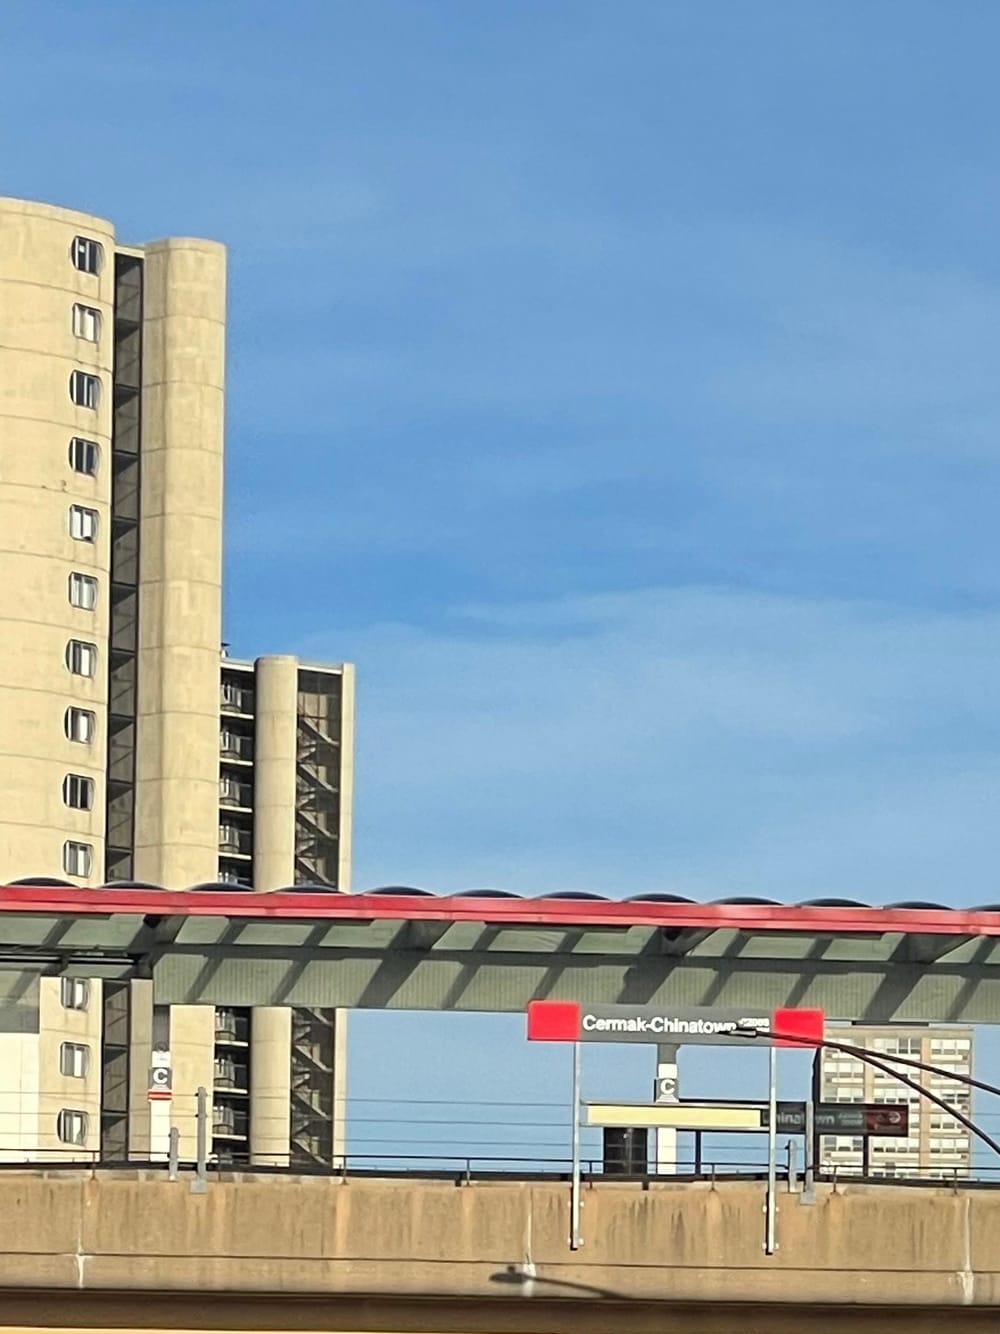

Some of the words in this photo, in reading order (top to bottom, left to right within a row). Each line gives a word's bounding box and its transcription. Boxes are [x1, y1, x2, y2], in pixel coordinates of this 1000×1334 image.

[582, 1014, 737, 1033] Cermak-Chinatown
[153, 1069, 167, 1084] C
[660, 1079, 675, 1094] C
